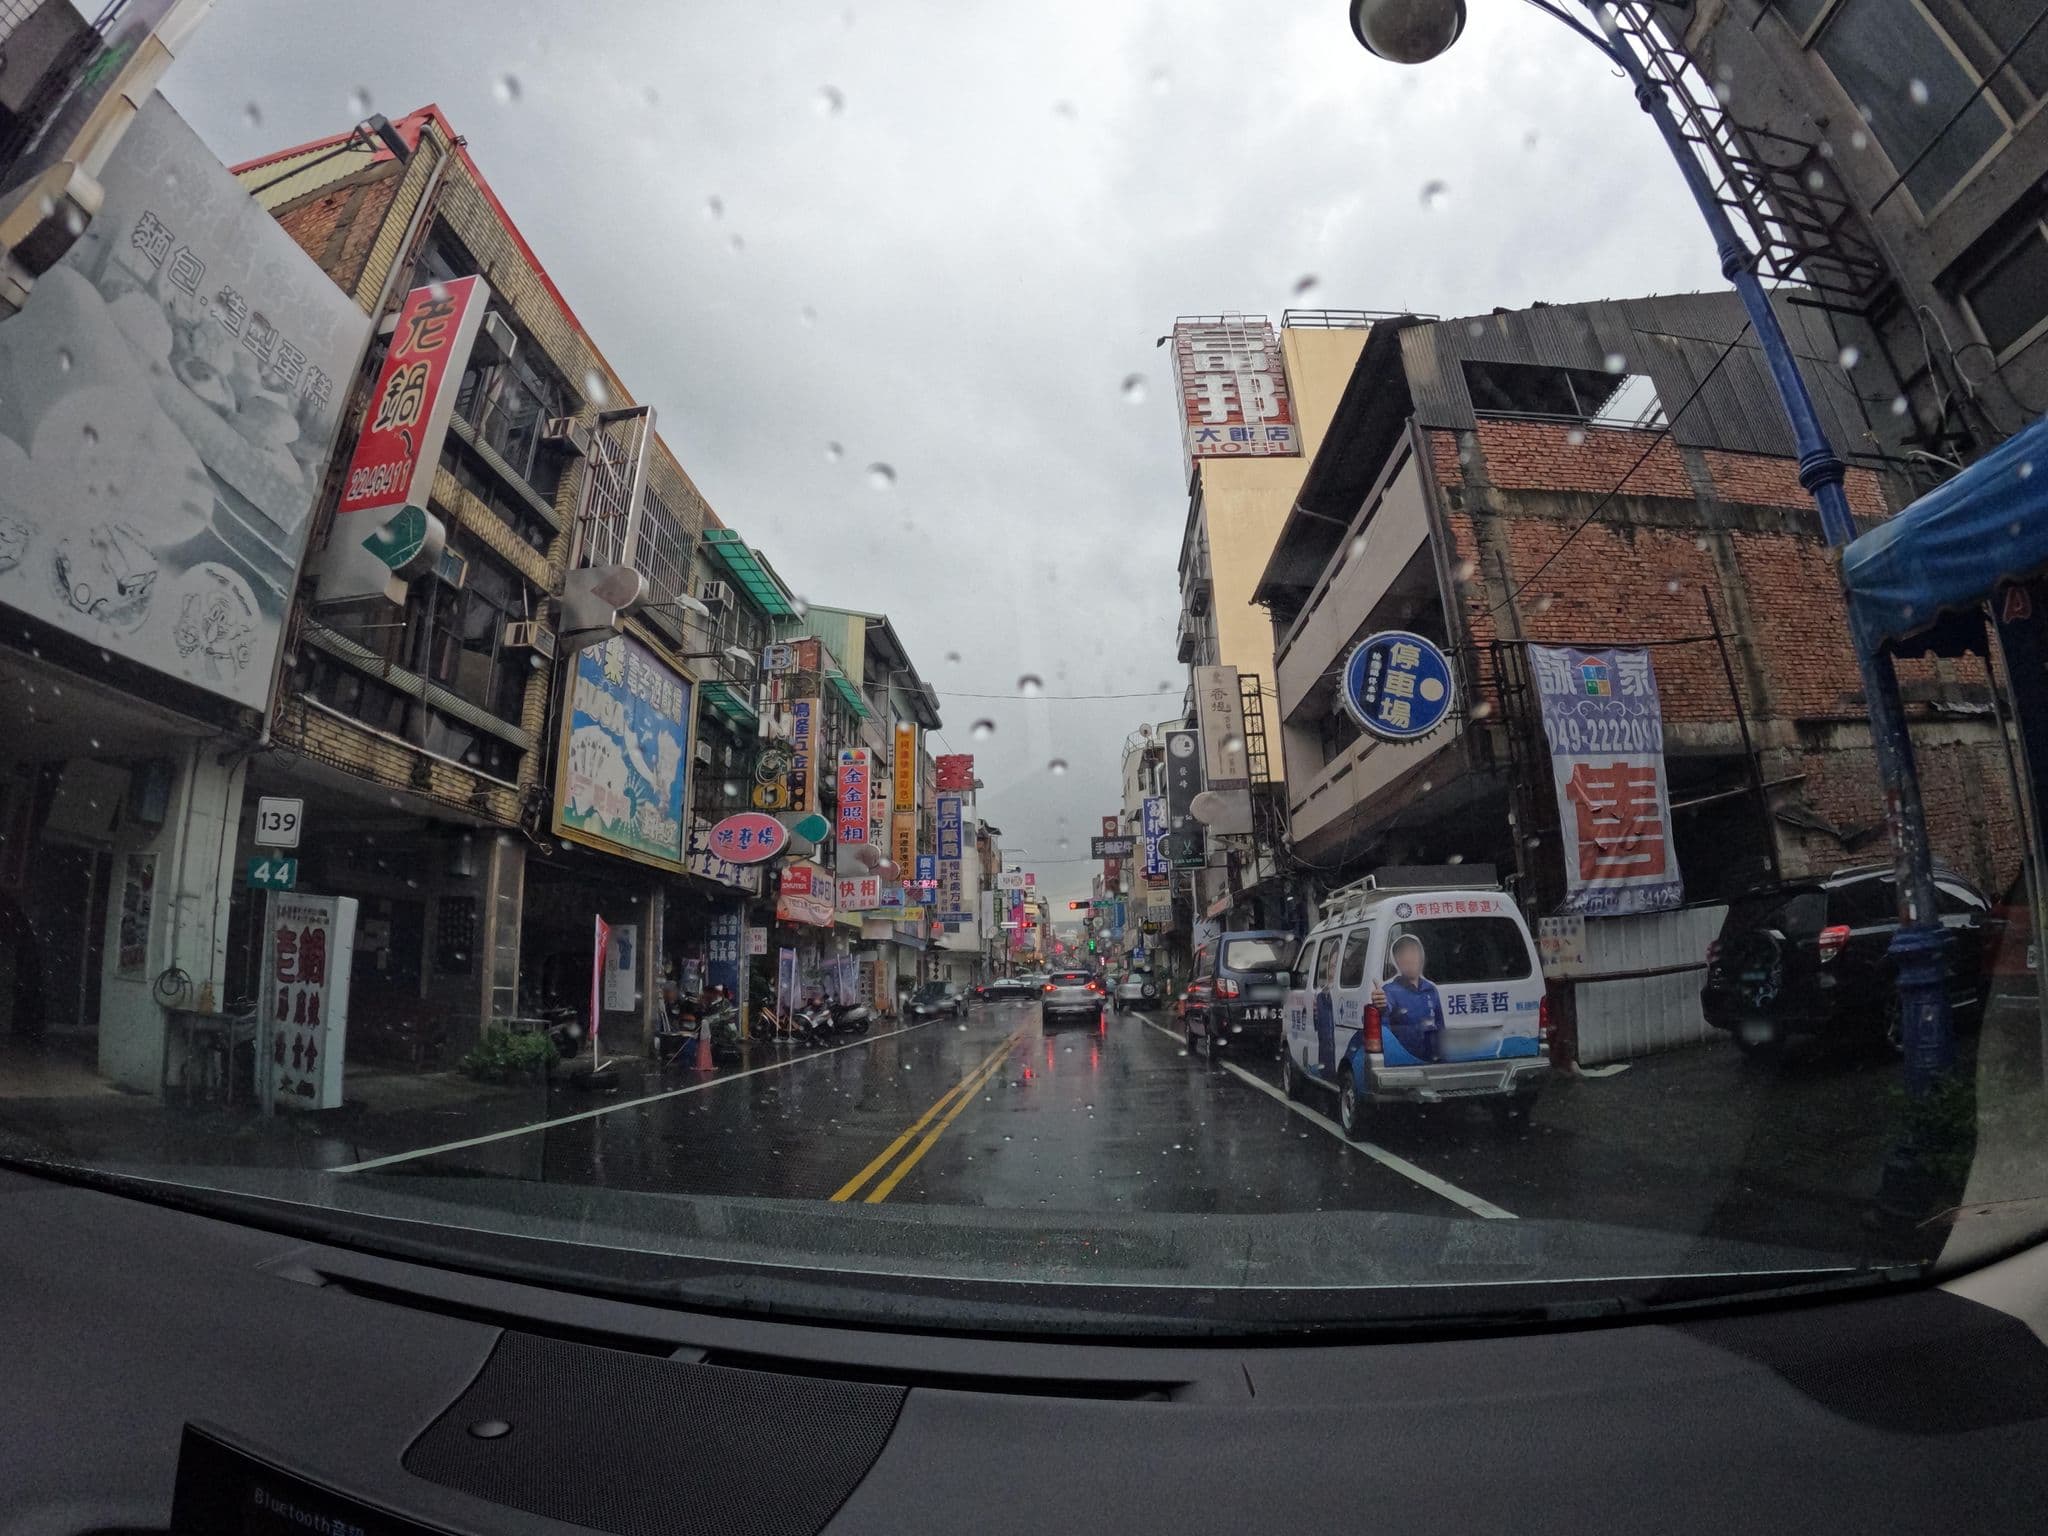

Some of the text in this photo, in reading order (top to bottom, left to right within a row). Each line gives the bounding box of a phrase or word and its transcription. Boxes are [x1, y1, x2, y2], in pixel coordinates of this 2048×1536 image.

[1194, 427, 1290, 442] 大飯店
[1197, 442, 1292, 453] HOTEL
[346, 458, 412, 501] 2246411
[1378, 641, 1422, 729] 停車場
[1614, 653, 1655, 697] 家
[842, 767, 864, 841] 金金照相
[260, 812, 296, 831] 139
[1566, 762, 1666, 881] 售
[1147, 836, 1157, 874] HOTEL
[253, 862, 290, 885] 44
[839, 880, 876, 897] 快相
[1447, 991, 1510, 1015] 張嘉哲
